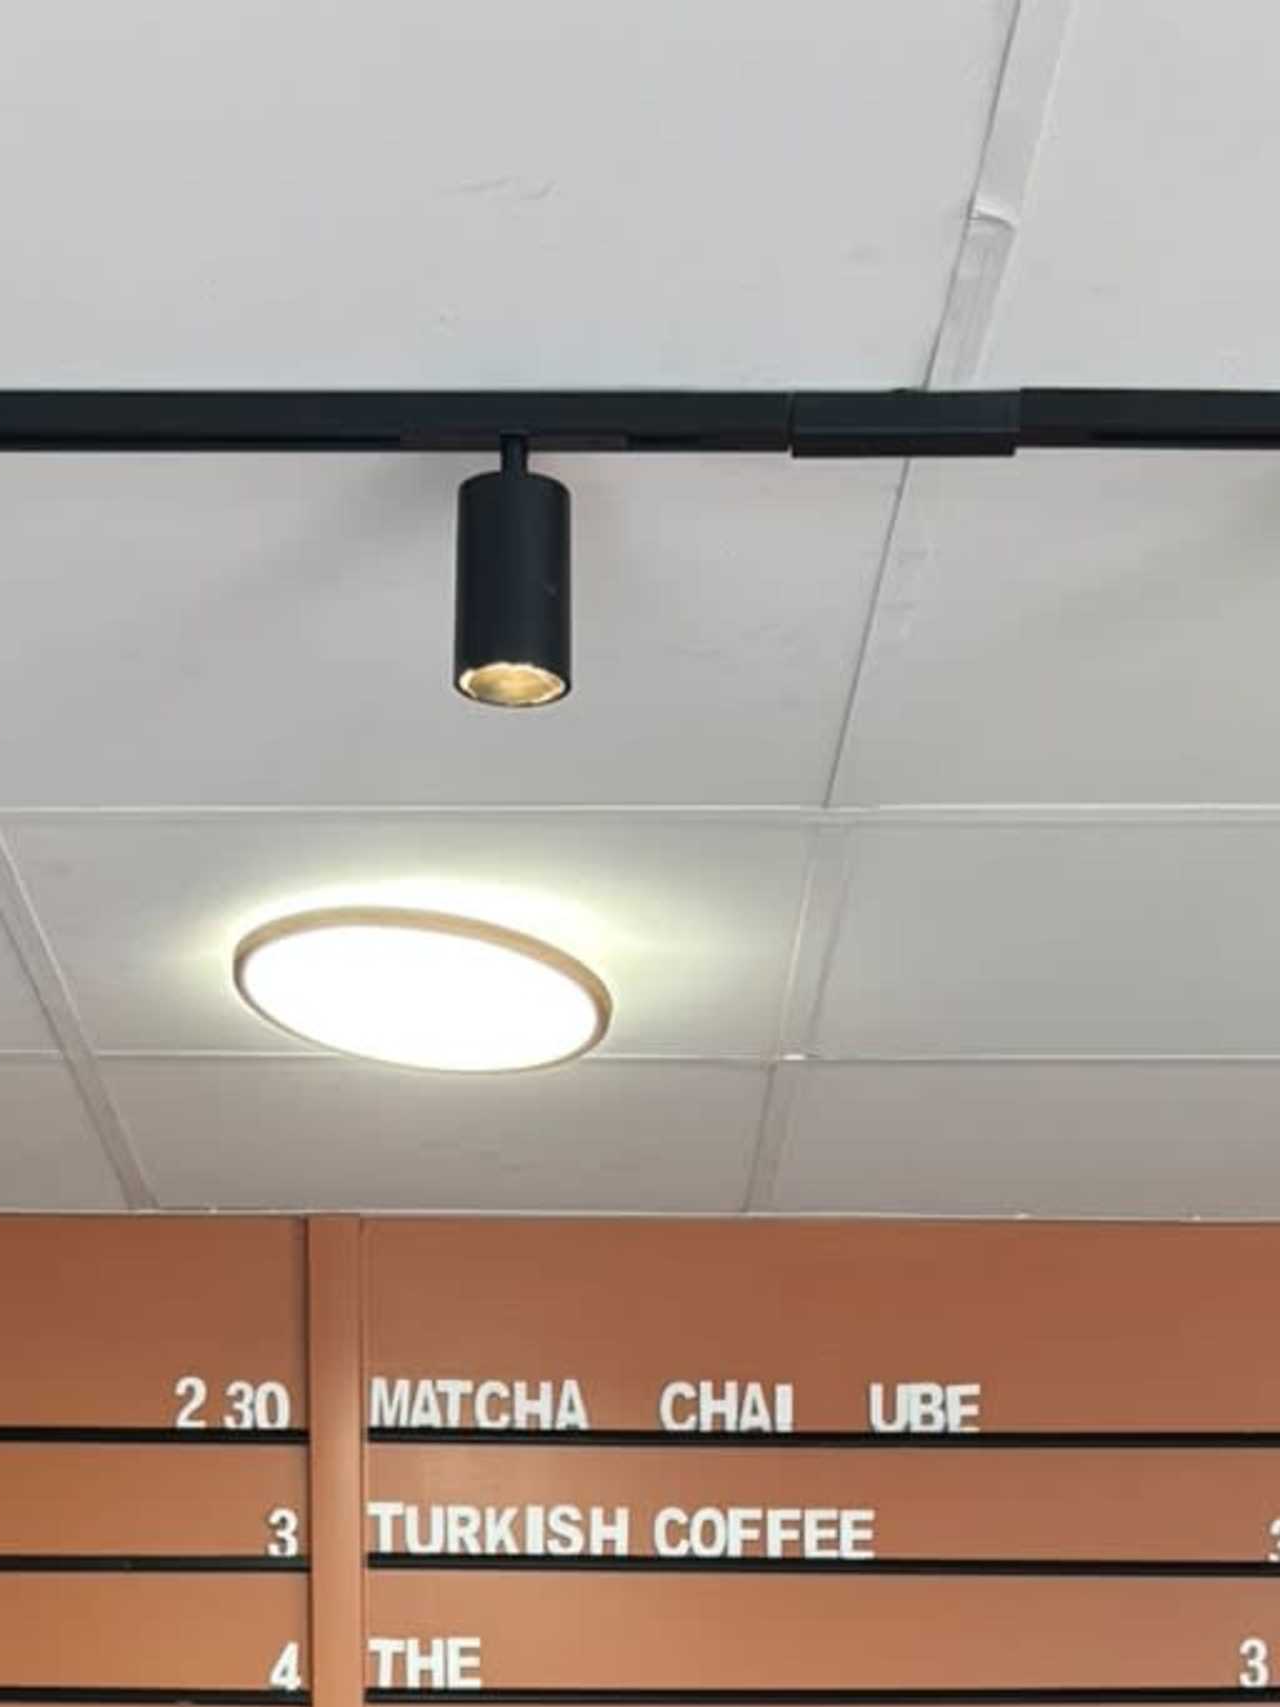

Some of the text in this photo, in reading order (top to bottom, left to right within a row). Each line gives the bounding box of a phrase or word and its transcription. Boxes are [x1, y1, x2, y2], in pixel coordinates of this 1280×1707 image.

[175, 1376, 207, 1429] 2
[223, 1380, 291, 1429] 30
[368, 1376, 590, 1430] MATCHA
[660, 1380, 793, 1432] CHAI
[870, 1382, 980, 1433] UBE
[267, 1508, 300, 1557] 3
[368, 1501, 629, 1556] TURKISH
[653, 1507, 876, 1559] COFFEE
[263, 1641, 304, 1691] 4
[368, 1636, 482, 1689] THE
[1239, 1638, 1269, 1688] 3
